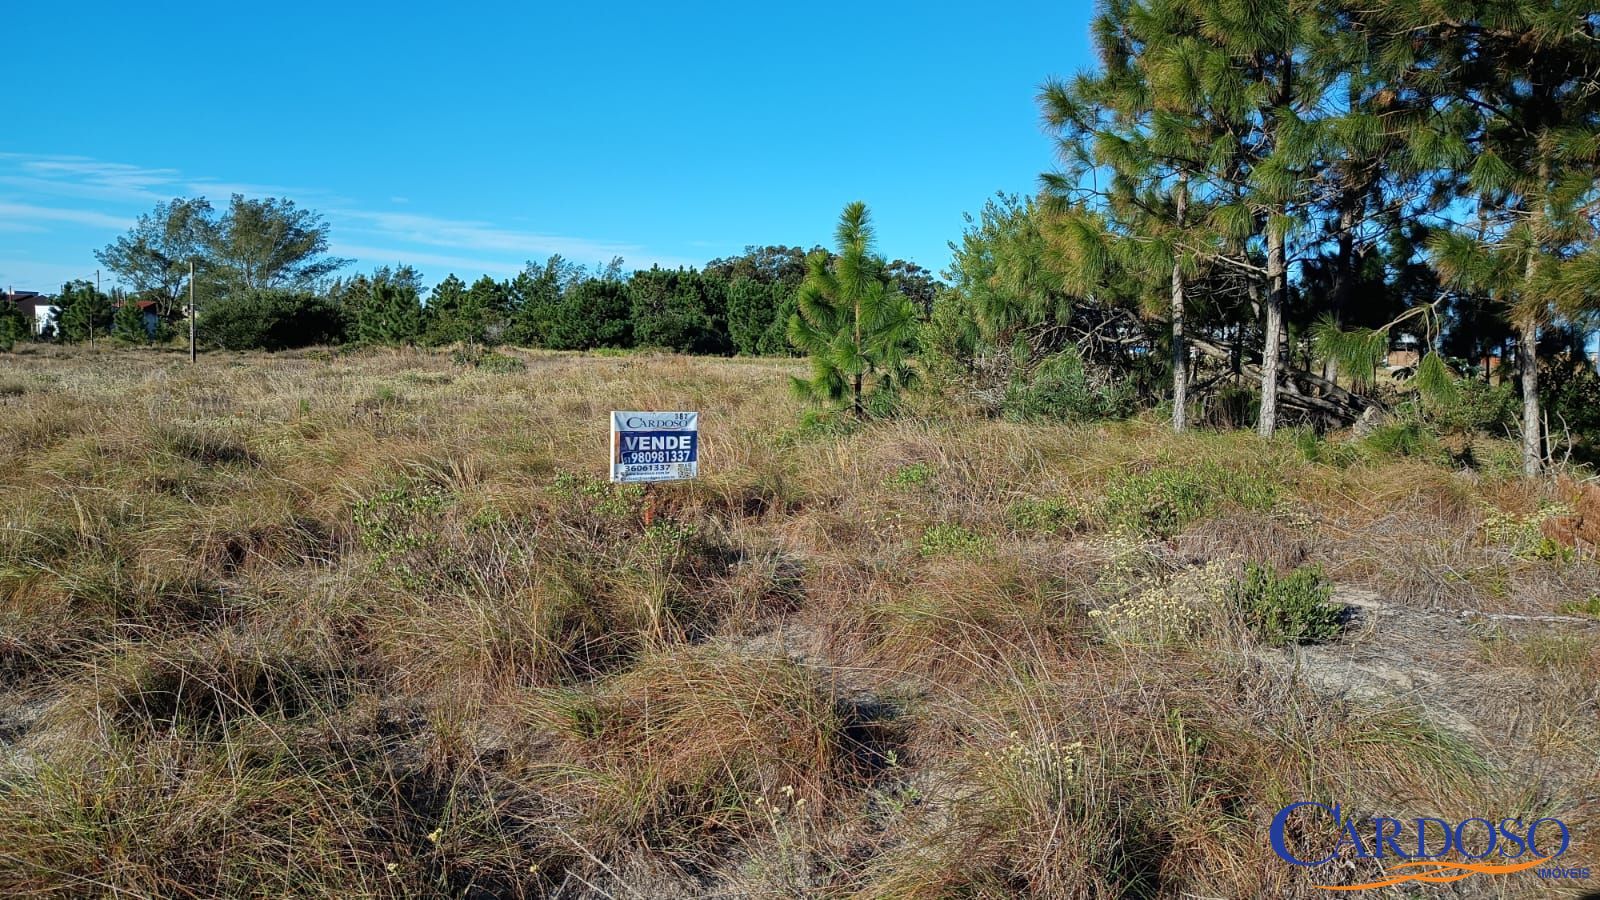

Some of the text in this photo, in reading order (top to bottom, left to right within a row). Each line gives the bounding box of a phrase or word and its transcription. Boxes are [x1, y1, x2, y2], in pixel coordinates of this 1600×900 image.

[626, 416, 688, 429] CARDOSO
[624, 436, 691, 451] VENDE
[631, 451, 690, 463] 980981337
[625, 464, 671, 472] 36061337
